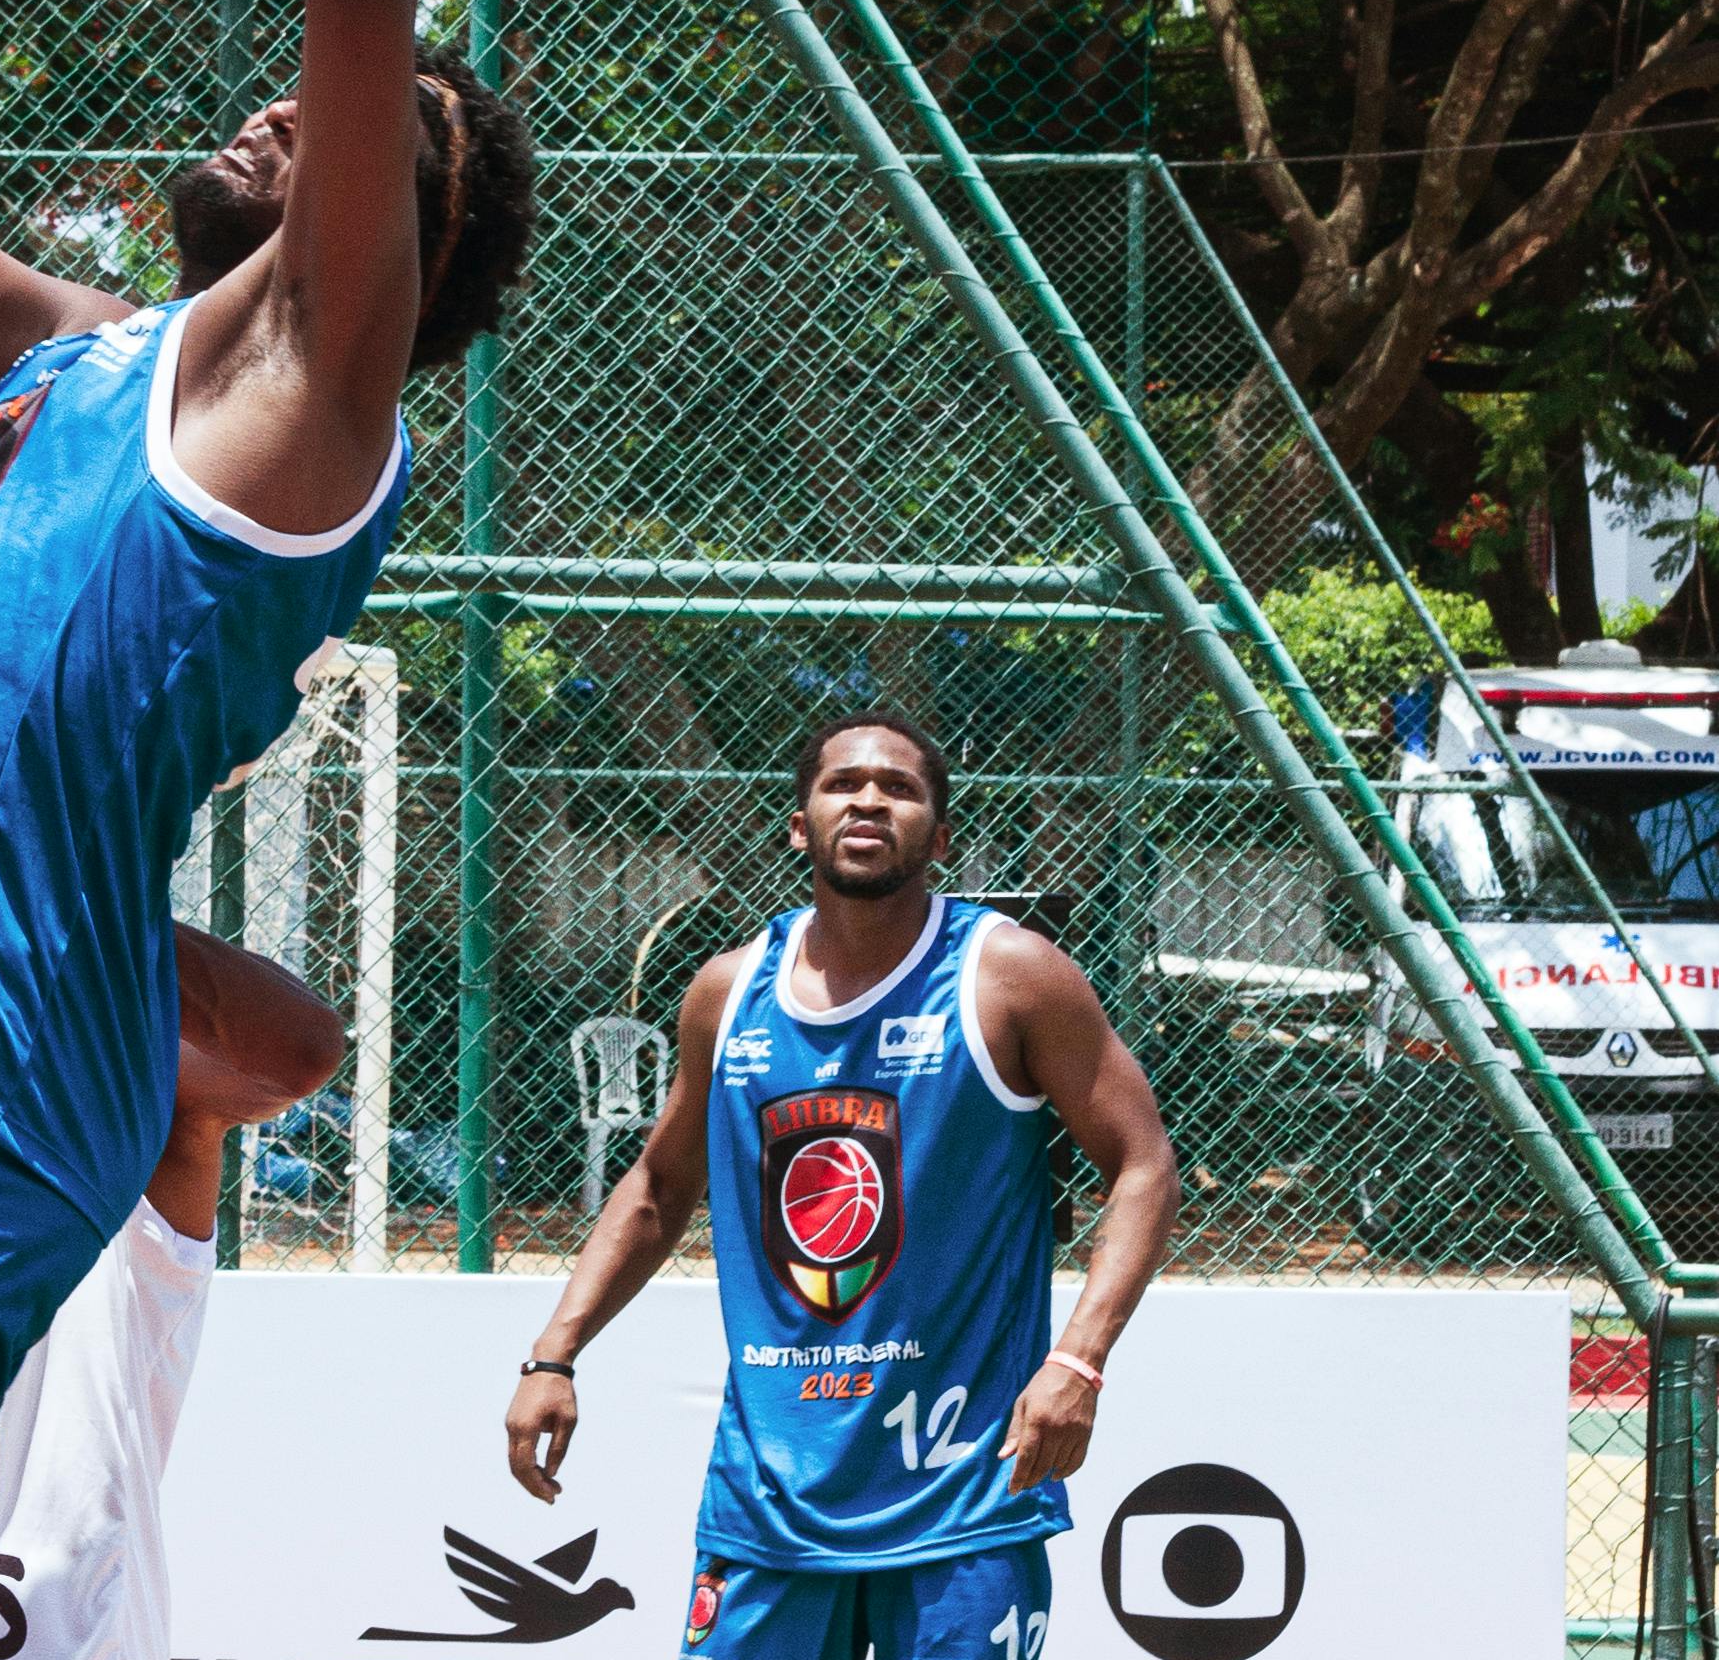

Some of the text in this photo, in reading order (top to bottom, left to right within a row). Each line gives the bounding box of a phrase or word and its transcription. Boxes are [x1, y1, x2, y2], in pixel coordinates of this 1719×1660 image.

[767, 1097, 886, 1138] LIIBRA
[835, 1340, 925, 1365] FEDERAL
[800, 1371, 875, 1401] 2023
[882, 1385, 978, 1471] 12
